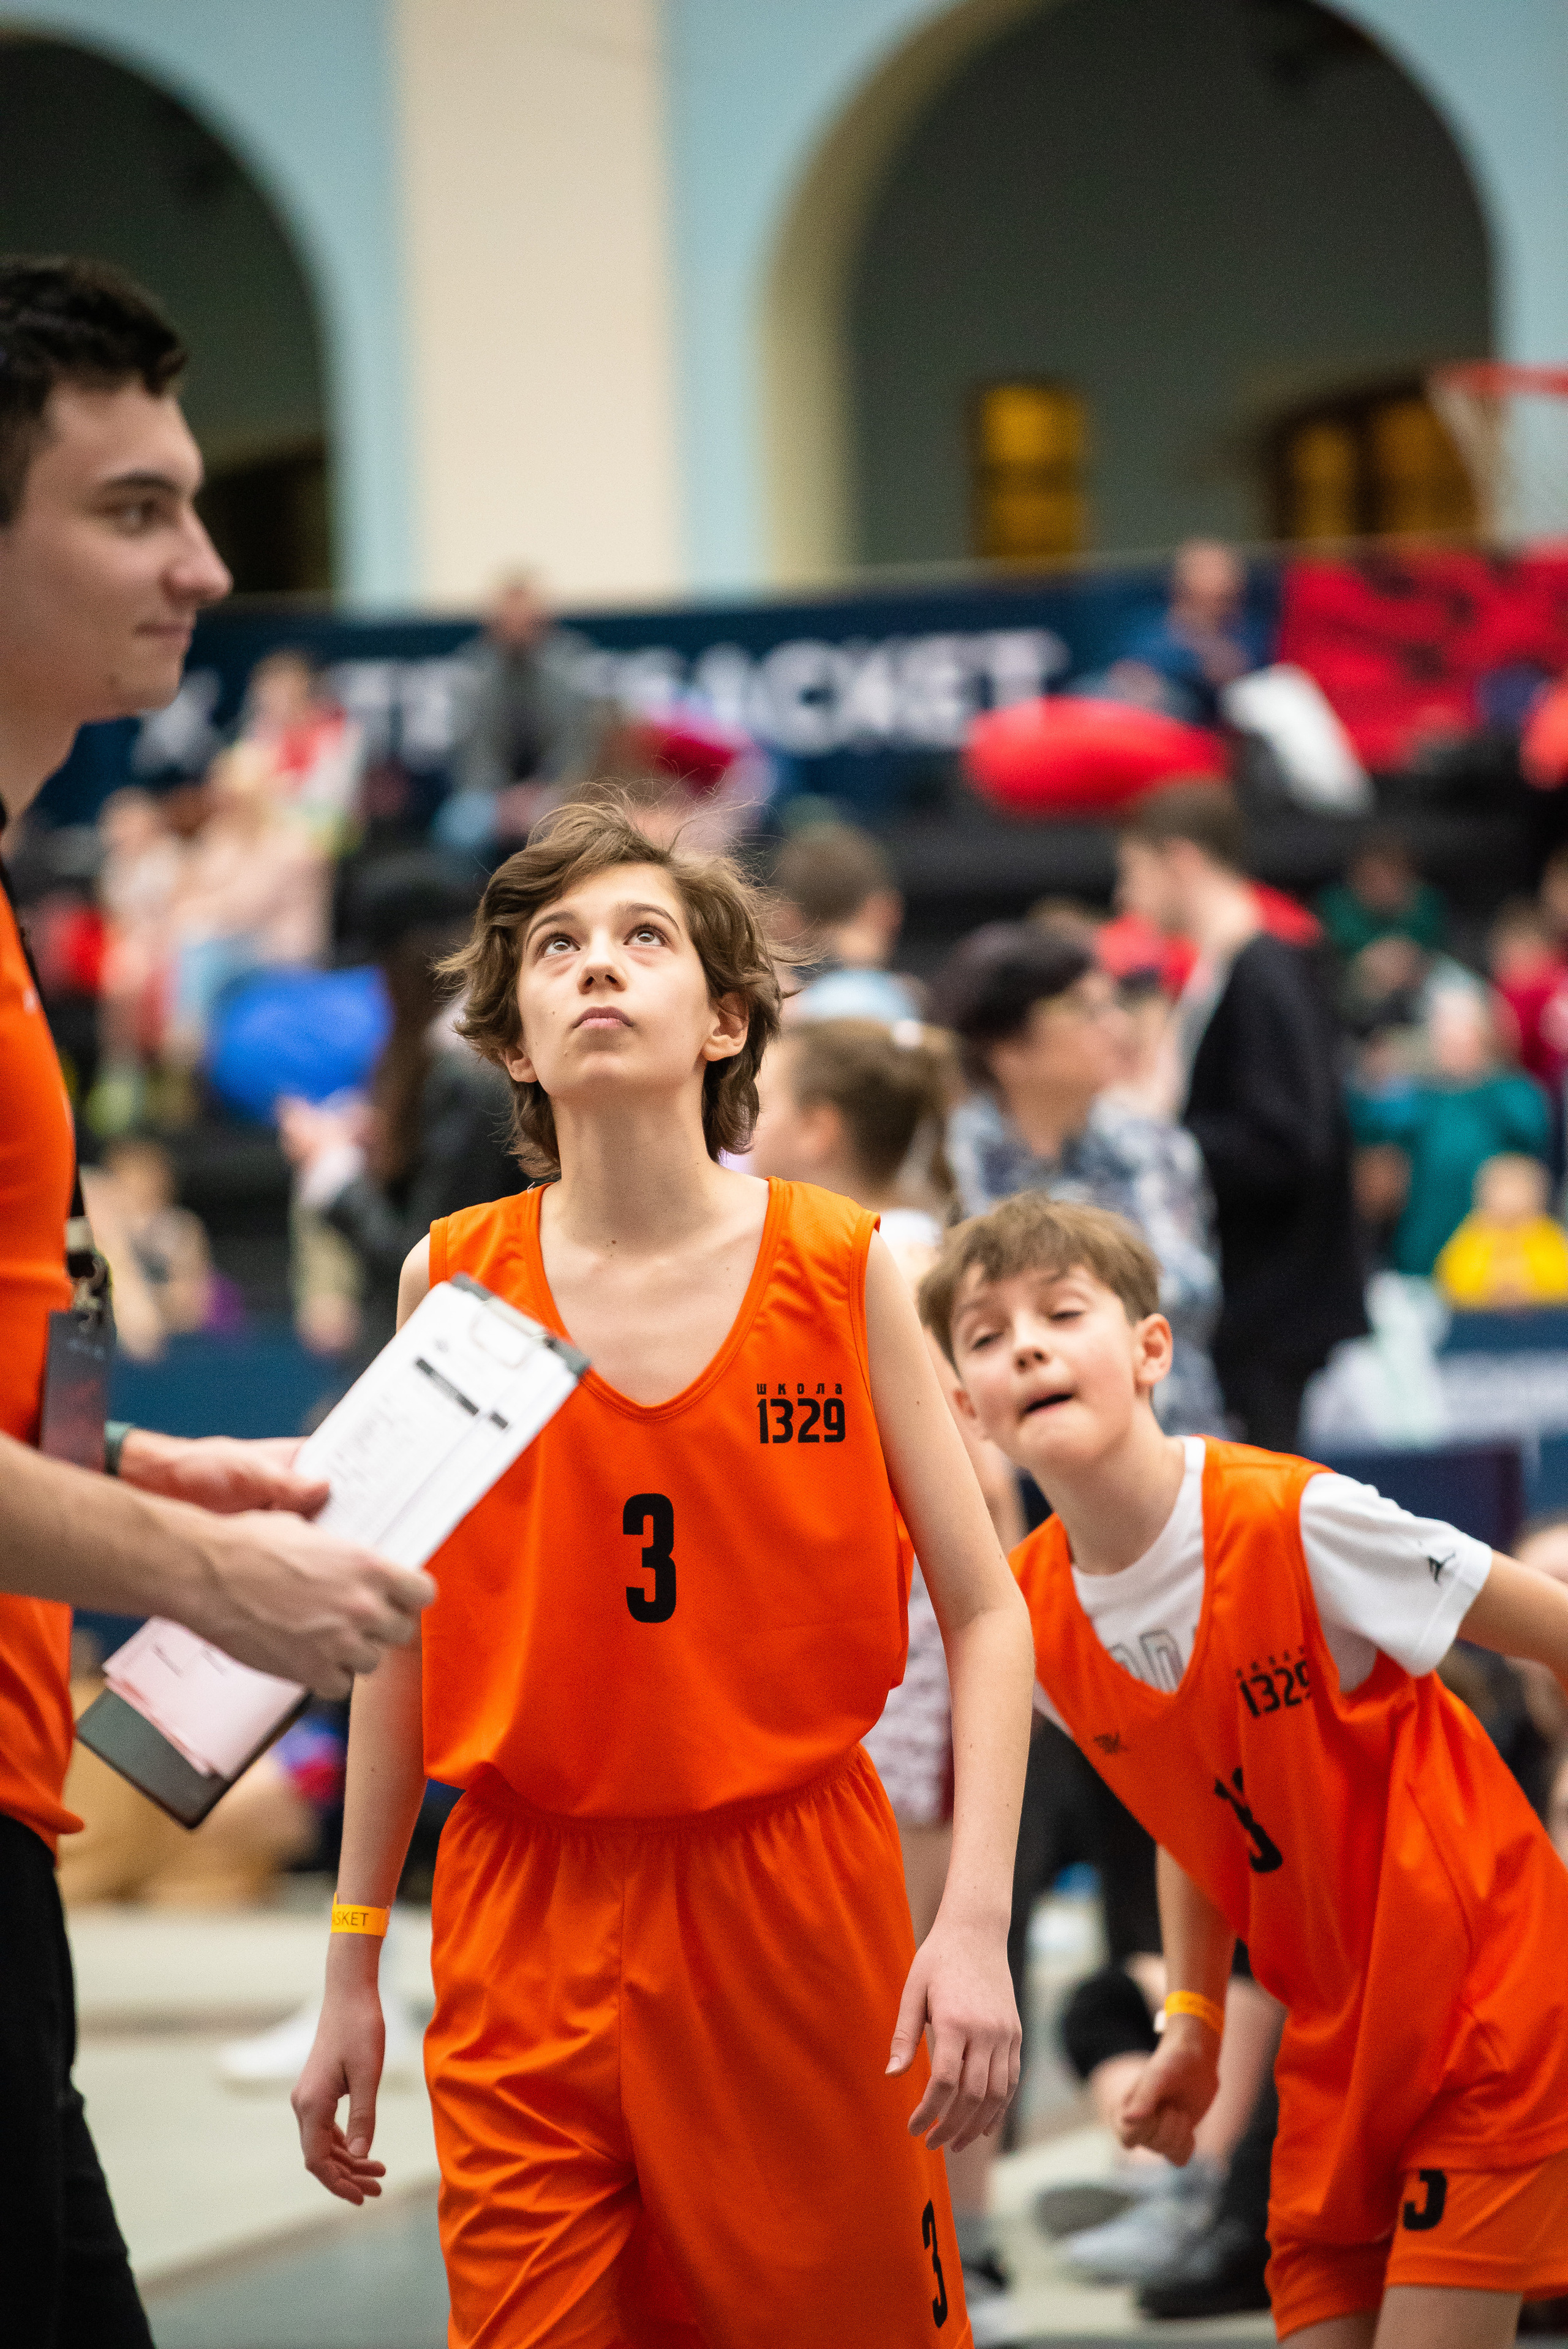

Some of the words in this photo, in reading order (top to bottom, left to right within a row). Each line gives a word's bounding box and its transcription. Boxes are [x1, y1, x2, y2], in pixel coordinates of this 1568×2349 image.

[756, 1398, 846, 1444] 1329
[622, 1493, 677, 1624] 3
[921, 2198, 948, 2329] 3
